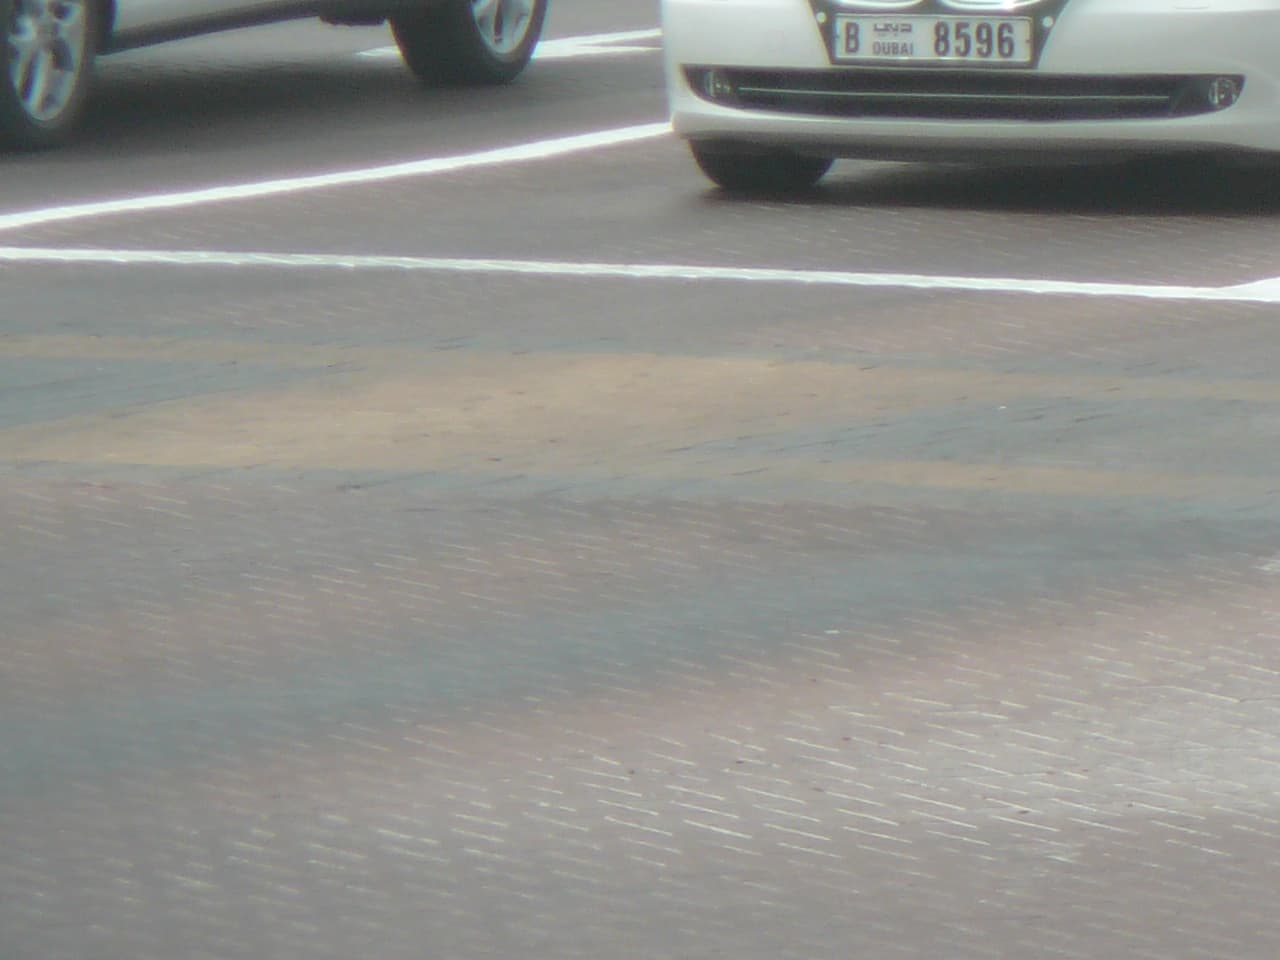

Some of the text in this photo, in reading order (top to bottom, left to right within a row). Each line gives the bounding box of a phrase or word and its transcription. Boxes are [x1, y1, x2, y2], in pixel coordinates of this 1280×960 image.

[844, 21, 1014, 57] B 8596
[872, 41, 913, 55] DUBAI
